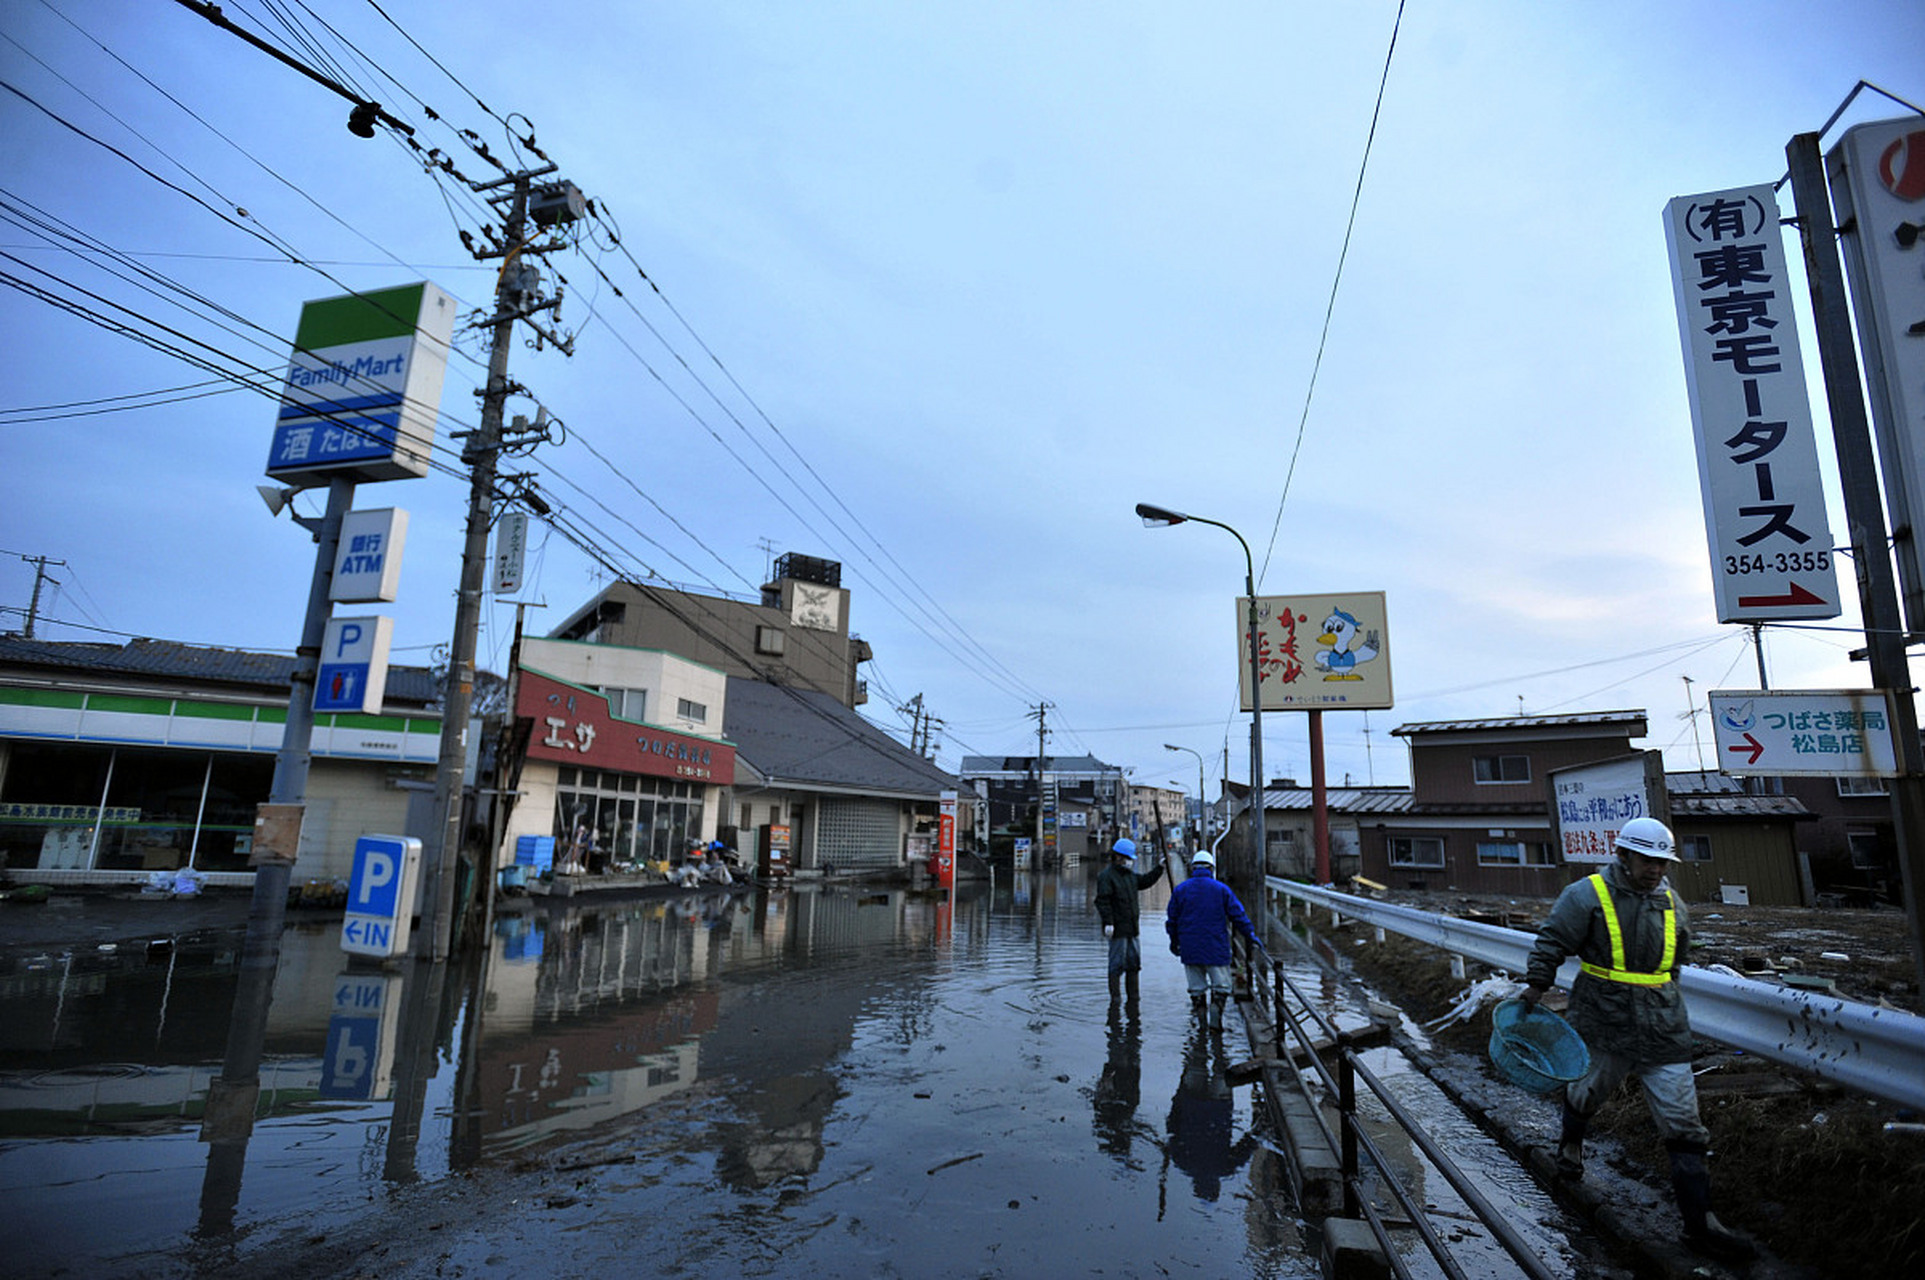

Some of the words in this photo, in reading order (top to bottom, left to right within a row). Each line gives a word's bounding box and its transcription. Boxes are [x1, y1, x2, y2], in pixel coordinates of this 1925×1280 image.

[289, 353, 404, 388] FamilyMart
[280, 427, 314, 461] 酒
[319, 423, 384, 454] たばこ
[350, 533, 383, 554] 銀行
[340, 554, 382, 575] ATM
[1725, 551, 1830, 576] 354-3355
[337, 624, 362, 659] P
[1763, 710, 1886, 731] つばさ薬局
[1792, 734, 1864, 754] 松島店
[358, 851, 394, 904] P
[363, 922, 389, 947] IN
